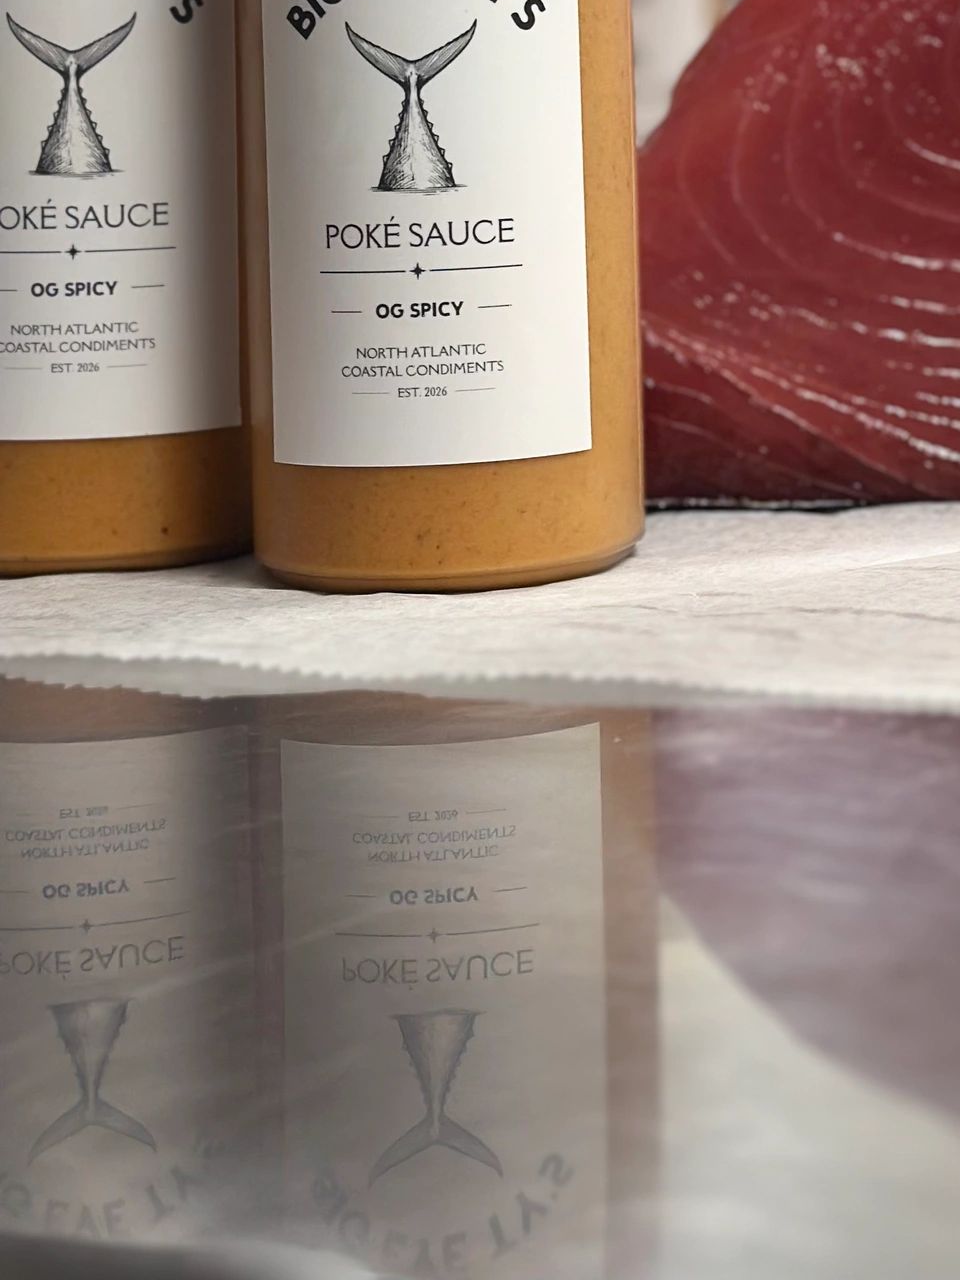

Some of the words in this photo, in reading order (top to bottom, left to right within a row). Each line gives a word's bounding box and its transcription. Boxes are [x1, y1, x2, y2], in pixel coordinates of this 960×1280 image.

[0, 198, 57, 230] OKÉ
[65, 202, 169, 229] SAUCE
[326, 216, 400, 249] POKÉ
[409, 218, 515, 248] SAUCE
[30, 282, 59, 297] OG
[64, 280, 118, 297] SPICY
[375, 303, 404, 319] OG
[410, 301, 464, 318] SPICY
[10, 324, 62, 336] NORTH
[65, 321, 139, 336] ATLANTIC
[59, 337, 156, 354] CONDIMENTS
[356, 346, 408, 360] NORTH
[411, 343, 487, 359] ATLANTIC
[77, 362, 100, 373] 2026
[341, 365, 403, 378] COASTAL
[406, 360, 504, 377] CONDIMENTS
[398, 387, 422, 398] EST.
[424, 386, 448, 398] 2026
